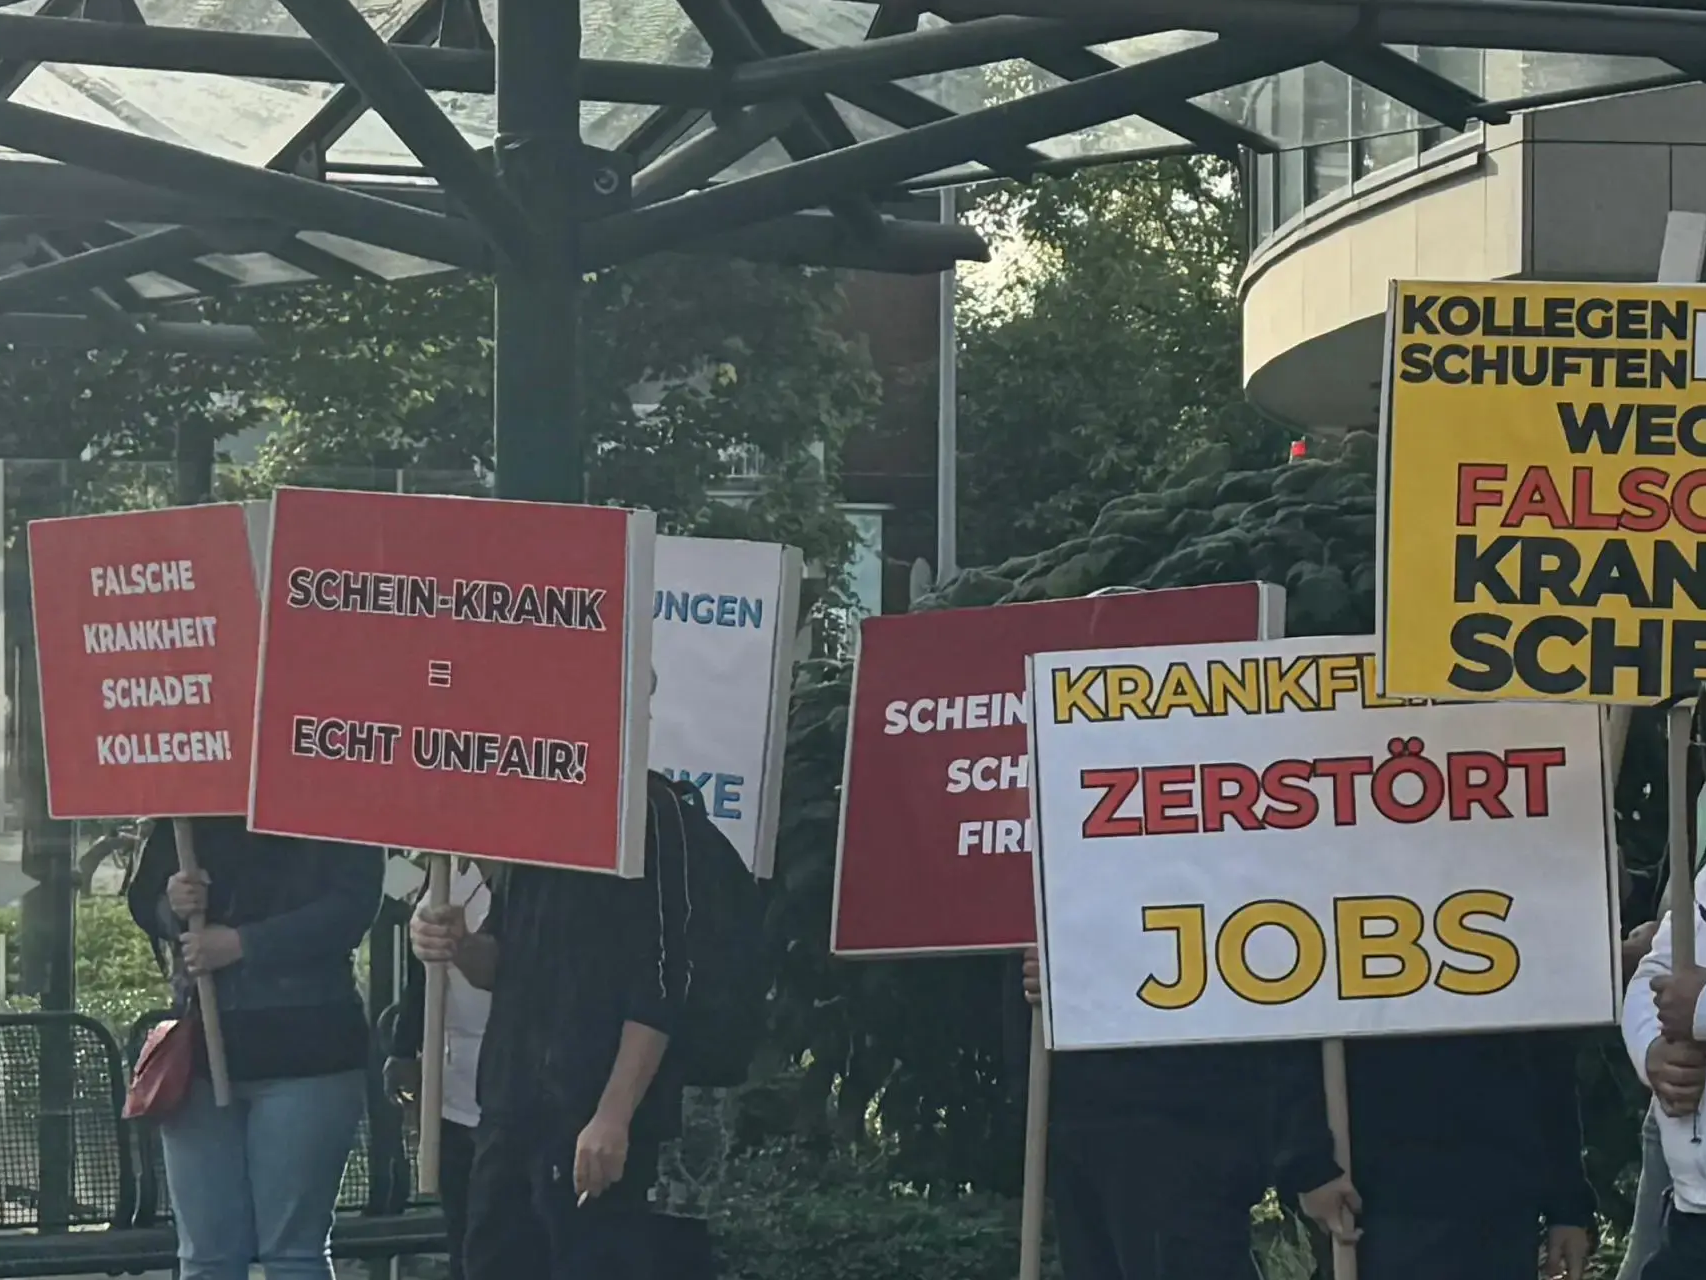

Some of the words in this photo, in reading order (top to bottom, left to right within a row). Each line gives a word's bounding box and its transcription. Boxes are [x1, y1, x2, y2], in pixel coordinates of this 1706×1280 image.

[1401, 294, 1690, 340] KOLLEGEN
[1399, 342, 1688, 389] SCHUFTEN
[90, 560, 195, 597] FALSCHE
[287, 567, 608, 632] SCHEIN-KRANK
[83, 616, 217, 654] KRANKHEIT
[101, 674, 213, 709] SCHADET
[884, 691, 1029, 735] SCHEIN
[96, 730, 233, 766] KOLLEGEN!
[292, 715, 402, 764] ECHT
[412, 727, 590, 784] UNFAIR!
[946, 754, 1030, 793] SCH
[1079, 735, 1568, 839] ZERSTÖRT
[957, 818, 1033, 856] FIR
[1135, 888, 1521, 1010] JOBS
